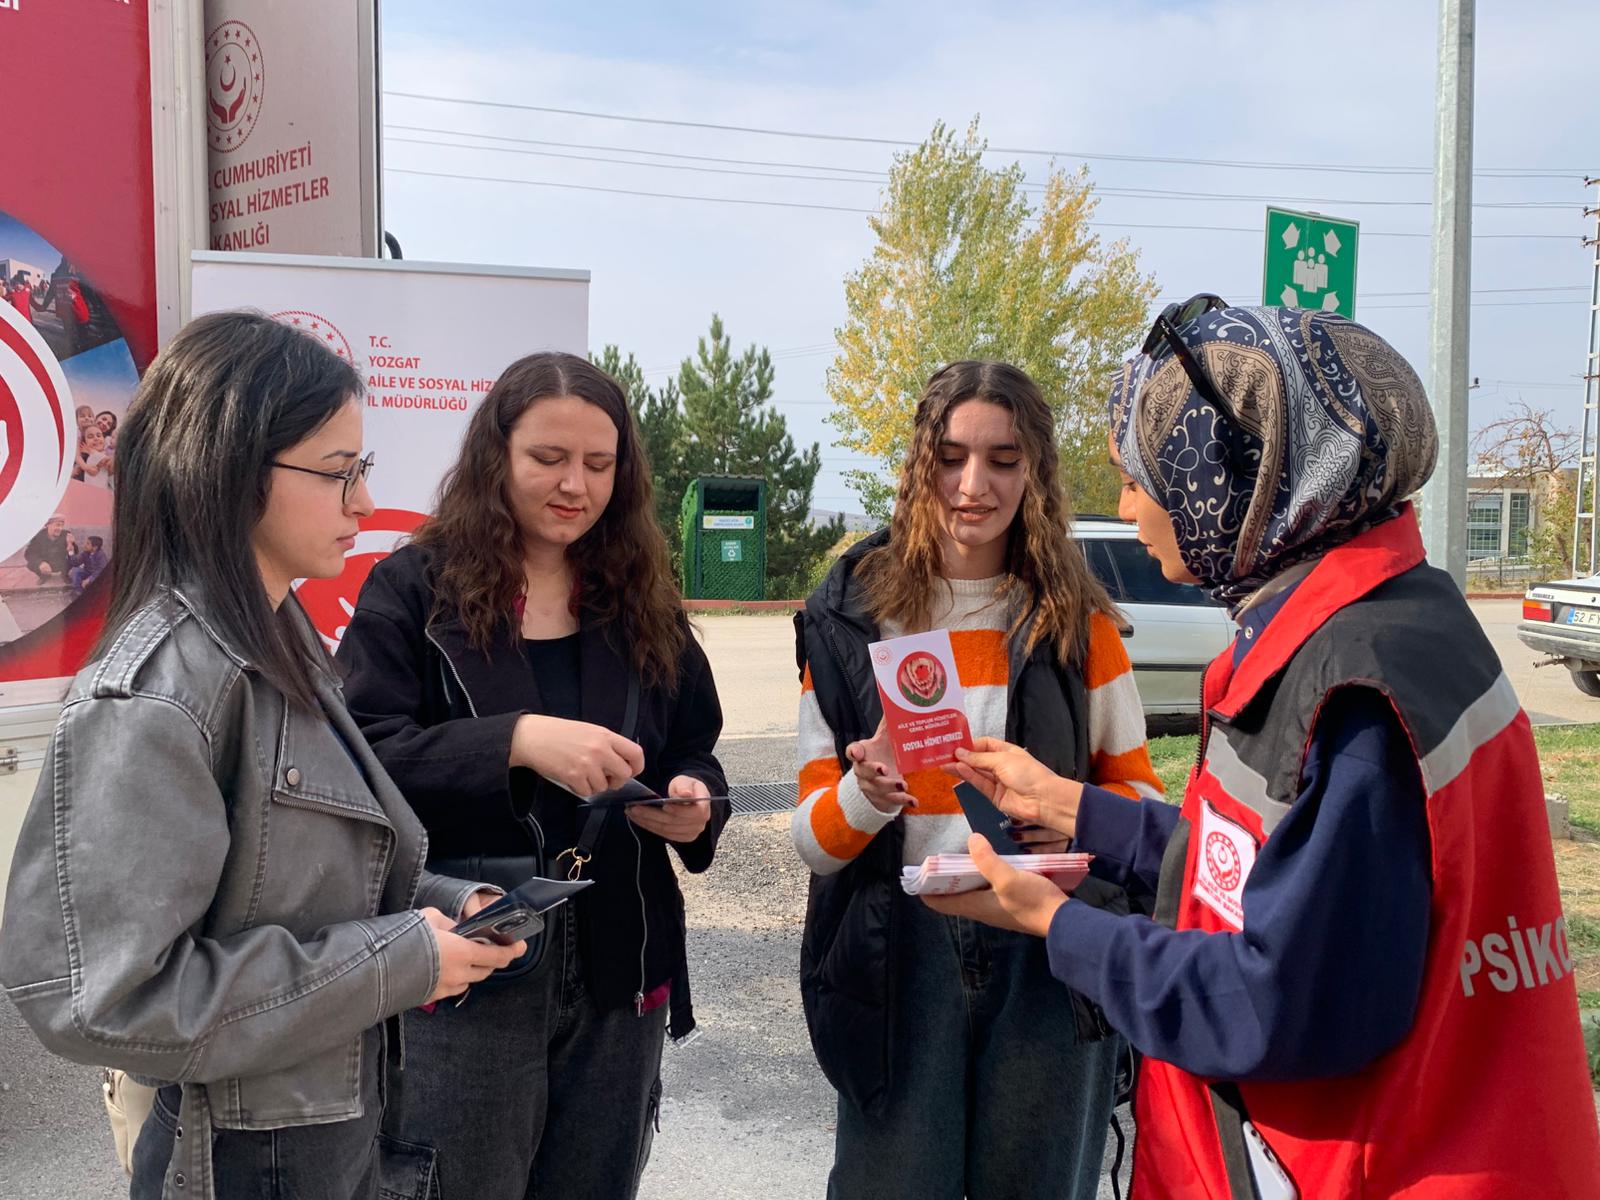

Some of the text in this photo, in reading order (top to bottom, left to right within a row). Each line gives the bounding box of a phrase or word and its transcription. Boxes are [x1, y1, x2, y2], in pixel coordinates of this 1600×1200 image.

[213, 141, 311, 189] CUMHURİYETİ
[247, 177, 329, 215] HİZMETLER
[210, 221, 269, 251] KANLIĞI
[369, 336, 392, 348] T.C.
[368, 356, 420, 369] YOZGAT
[368, 373, 497, 392] AİLE VE SOSYAL HİZ
[367, 393, 467, 411] İL MÜDÜRLÜĞÜ
[1574, 612, 1585, 623] 52
